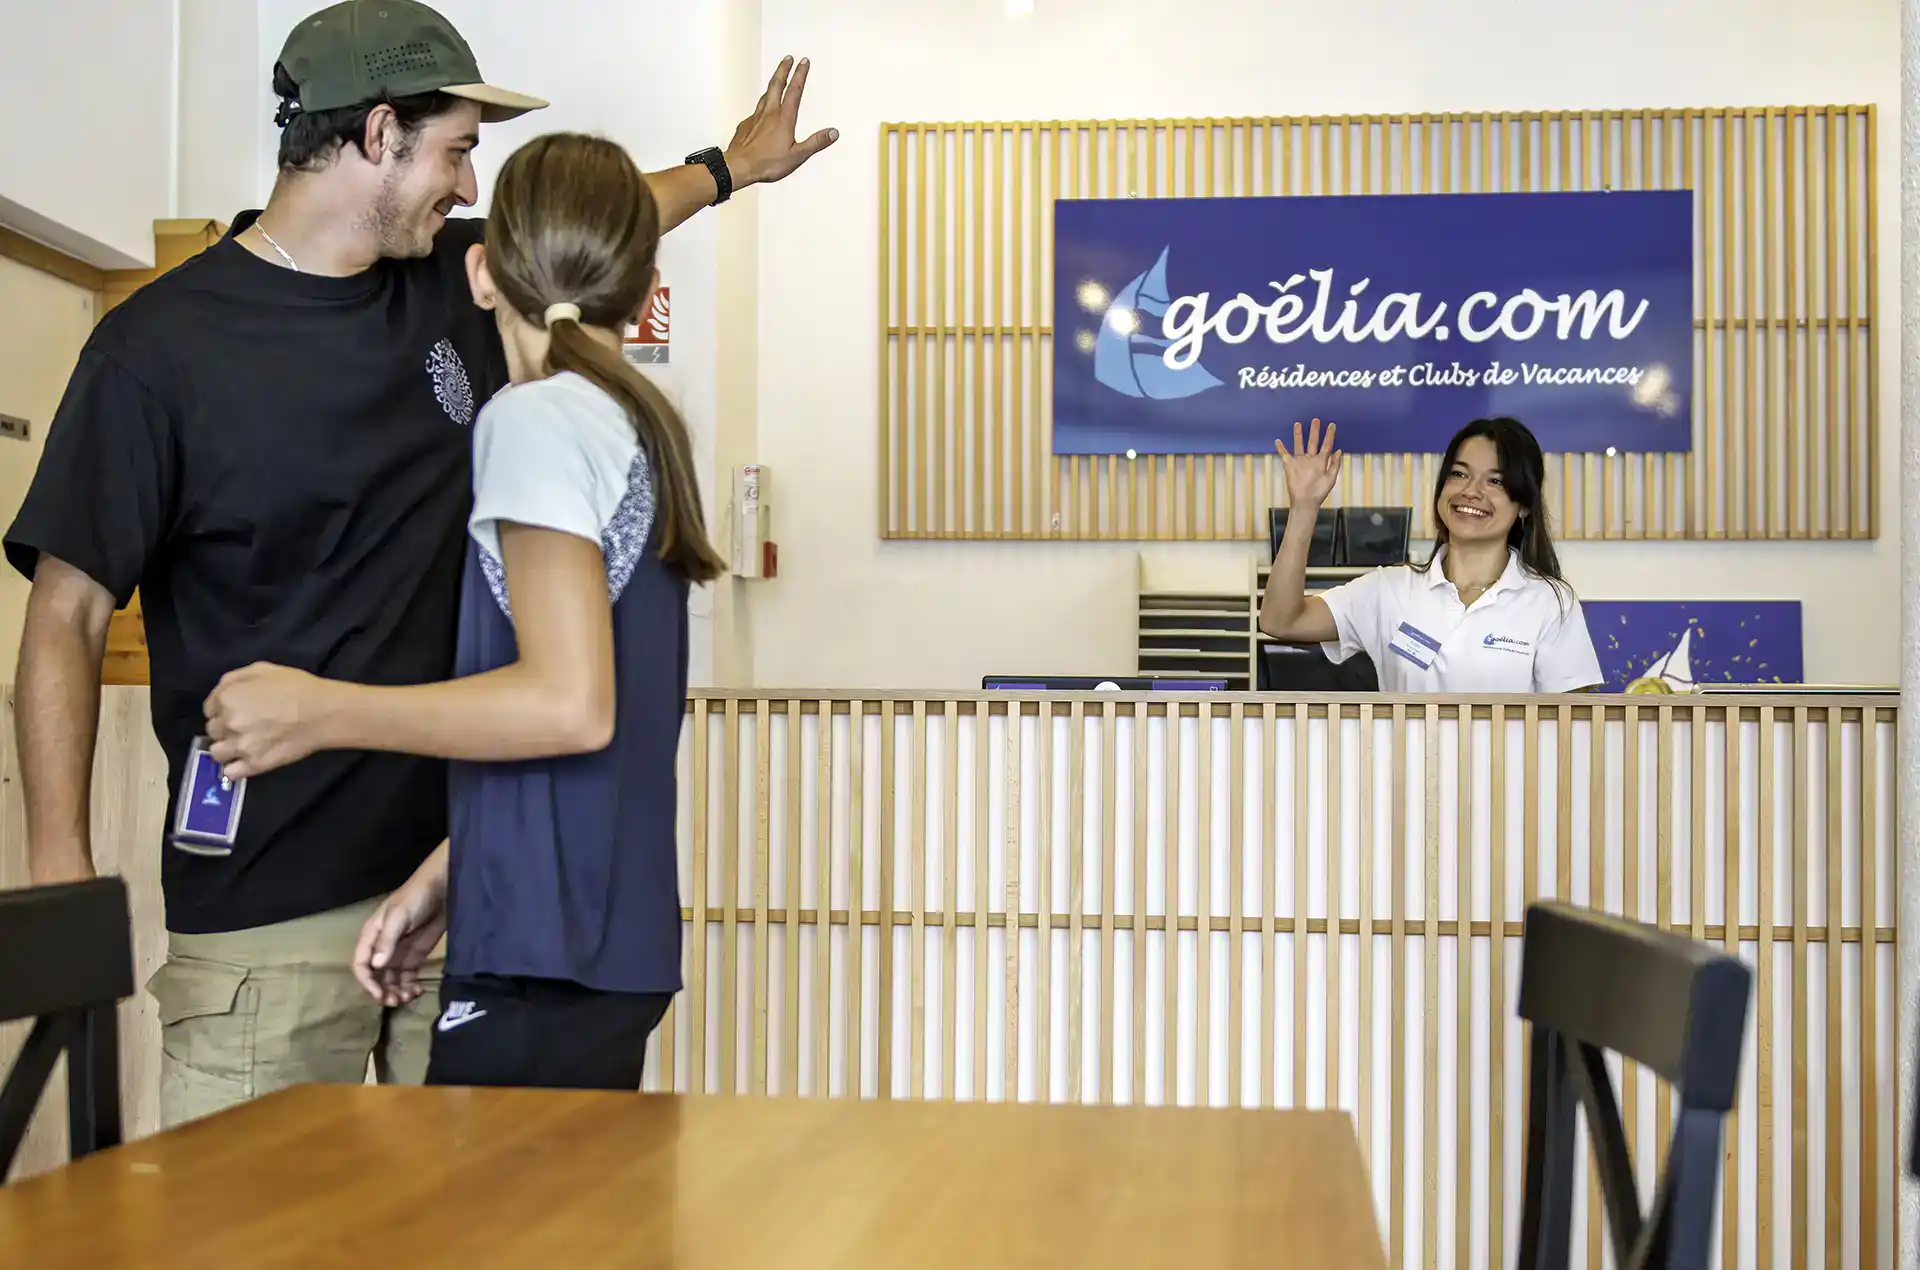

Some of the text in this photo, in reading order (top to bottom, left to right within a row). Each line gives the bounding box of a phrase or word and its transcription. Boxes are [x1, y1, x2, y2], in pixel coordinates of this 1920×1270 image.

[1238, 361, 1645, 390] Résidences et Clubs de Vacances
